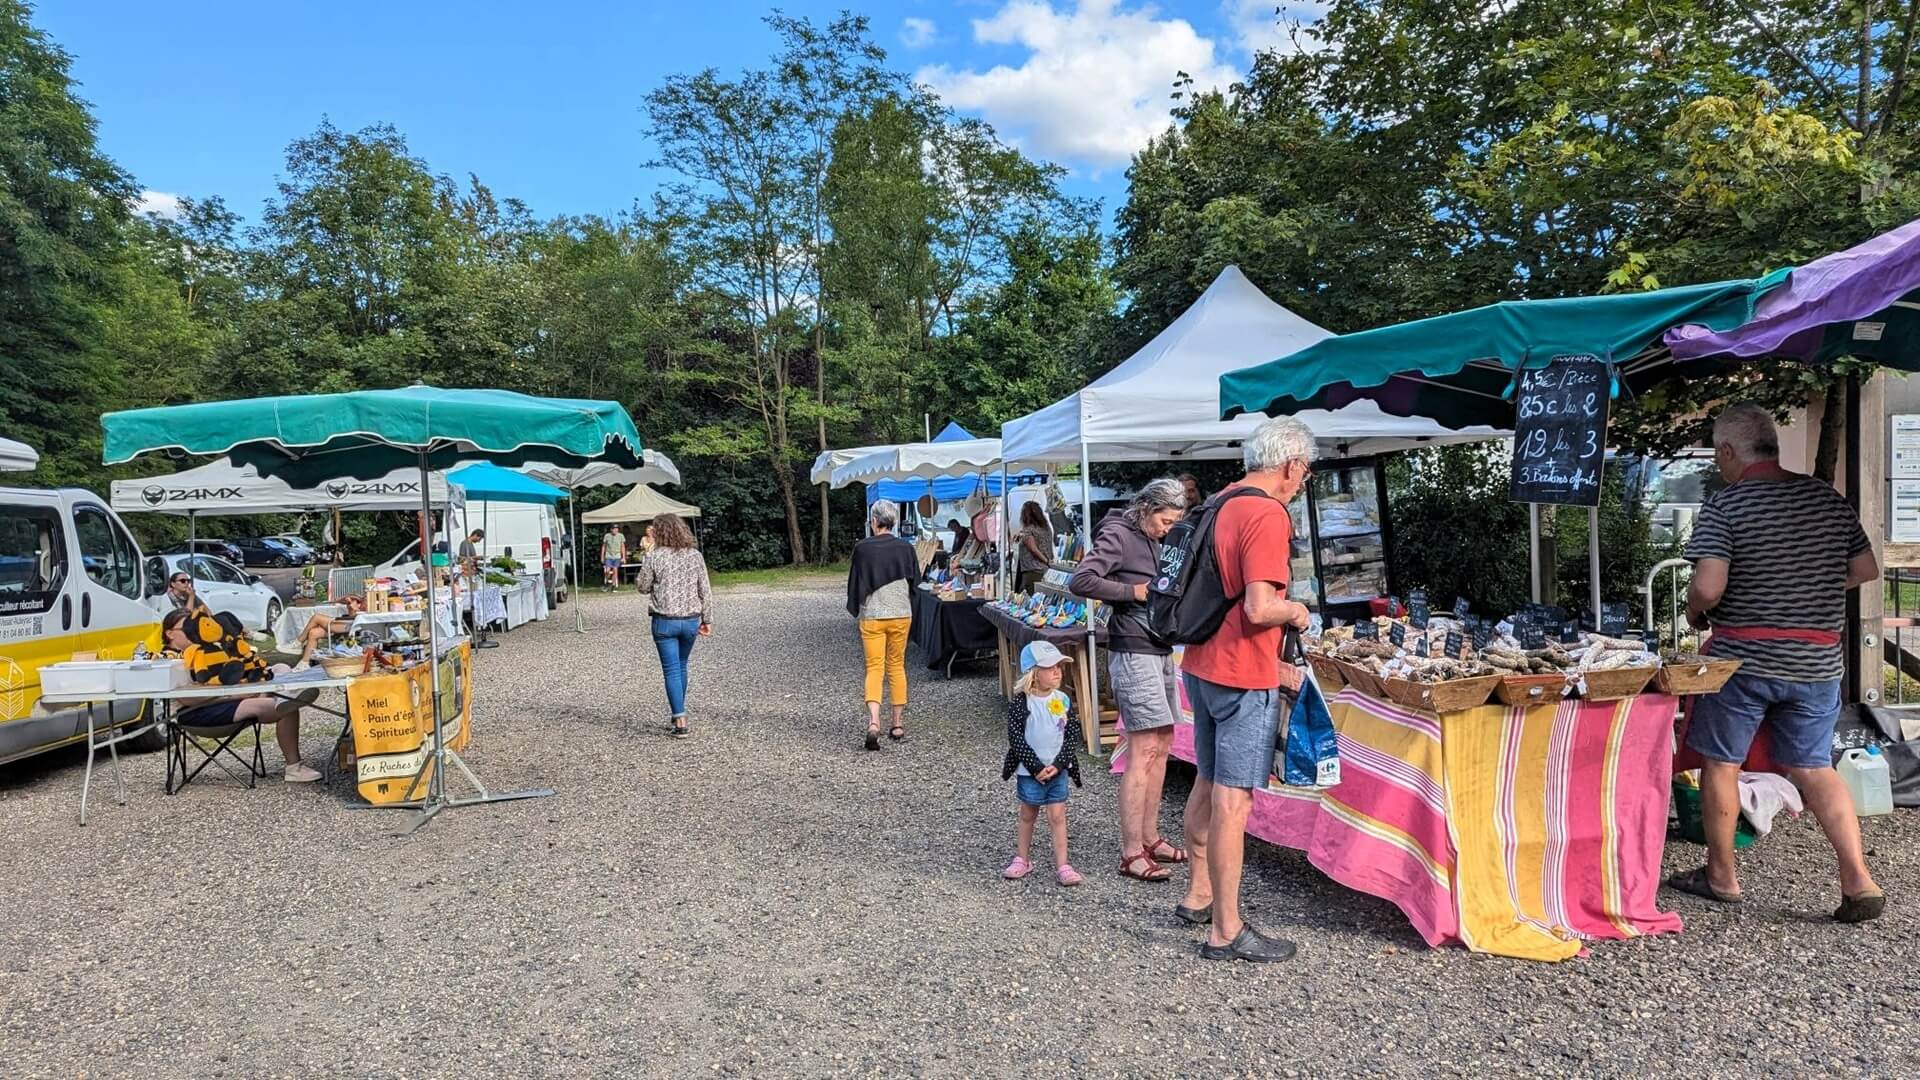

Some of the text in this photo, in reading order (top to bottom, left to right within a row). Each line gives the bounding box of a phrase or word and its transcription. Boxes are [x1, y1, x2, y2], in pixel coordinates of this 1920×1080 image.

[1582, 392, 1599, 416] 2
[1517, 429, 1547, 460] 12
[1579, 430, 1597, 458] 3
[1518, 466, 1530, 484] 3
[169, 487, 244, 501] 24MX
[351, 482, 421, 495] 24MX
[366, 698, 388, 709] Miel
[368, 713, 391, 723] Pain
[360, 763, 376, 777] Les
[379, 760, 412, 774] Ruches
